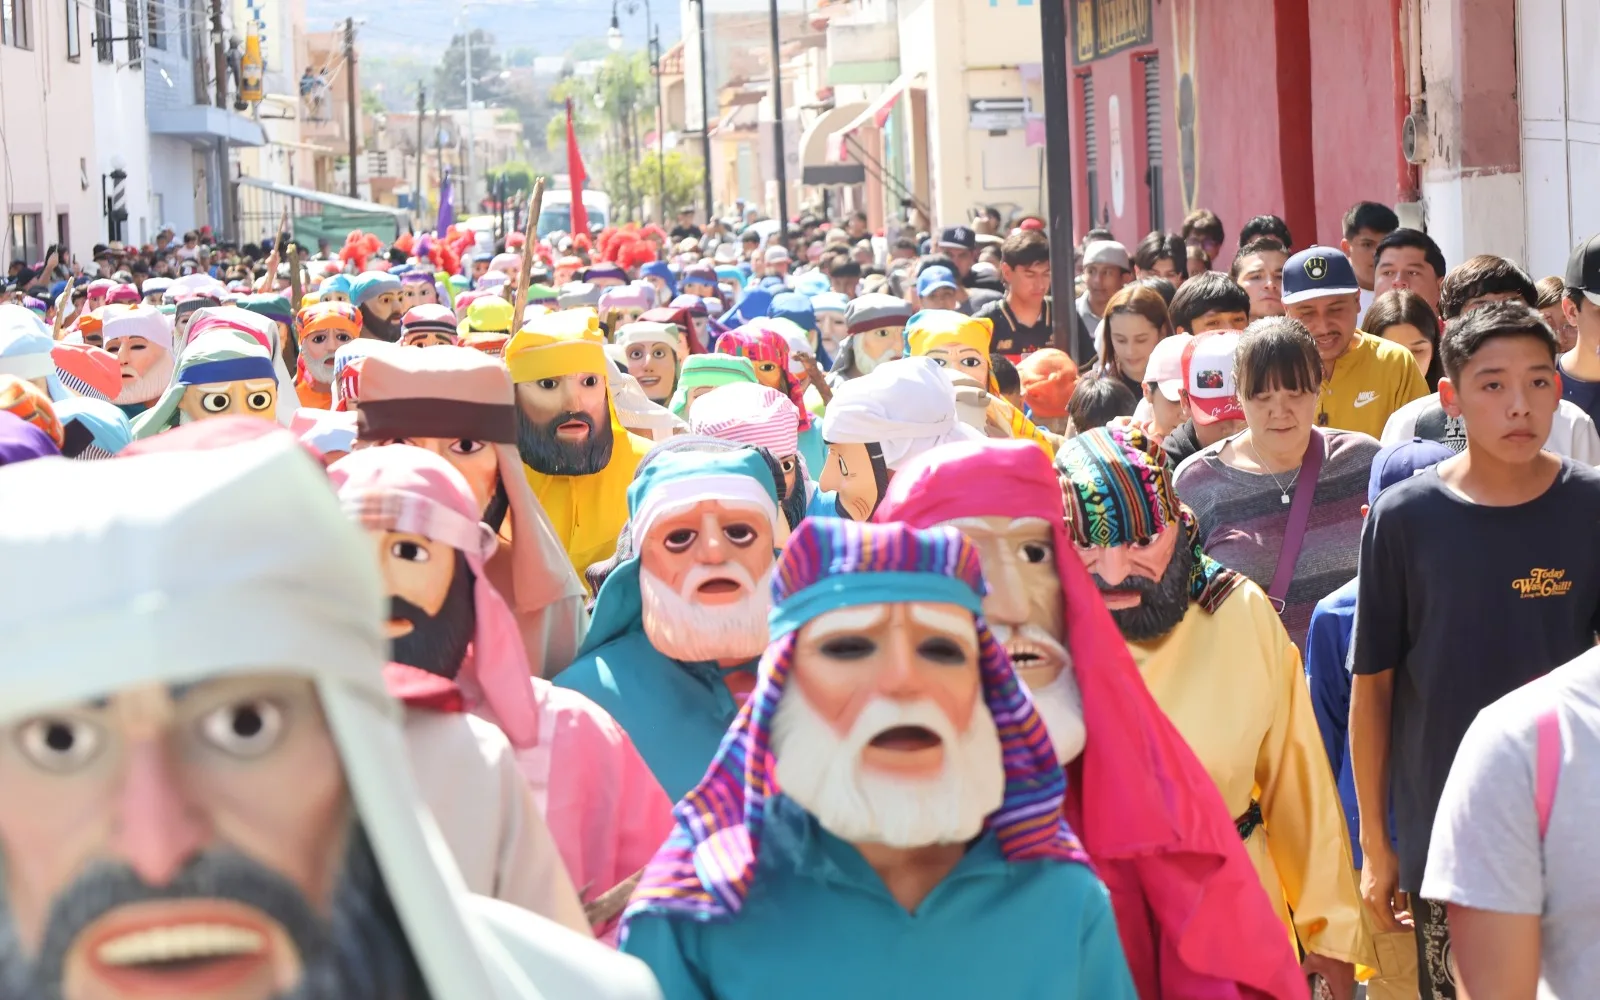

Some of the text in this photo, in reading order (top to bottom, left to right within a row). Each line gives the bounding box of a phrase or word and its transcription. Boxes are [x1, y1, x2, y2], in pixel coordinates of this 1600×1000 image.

[1357, 390, 1375, 401] NIKE
[1530, 568, 1565, 584] Today
[1512, 578, 1572, 597] Was Chill!
